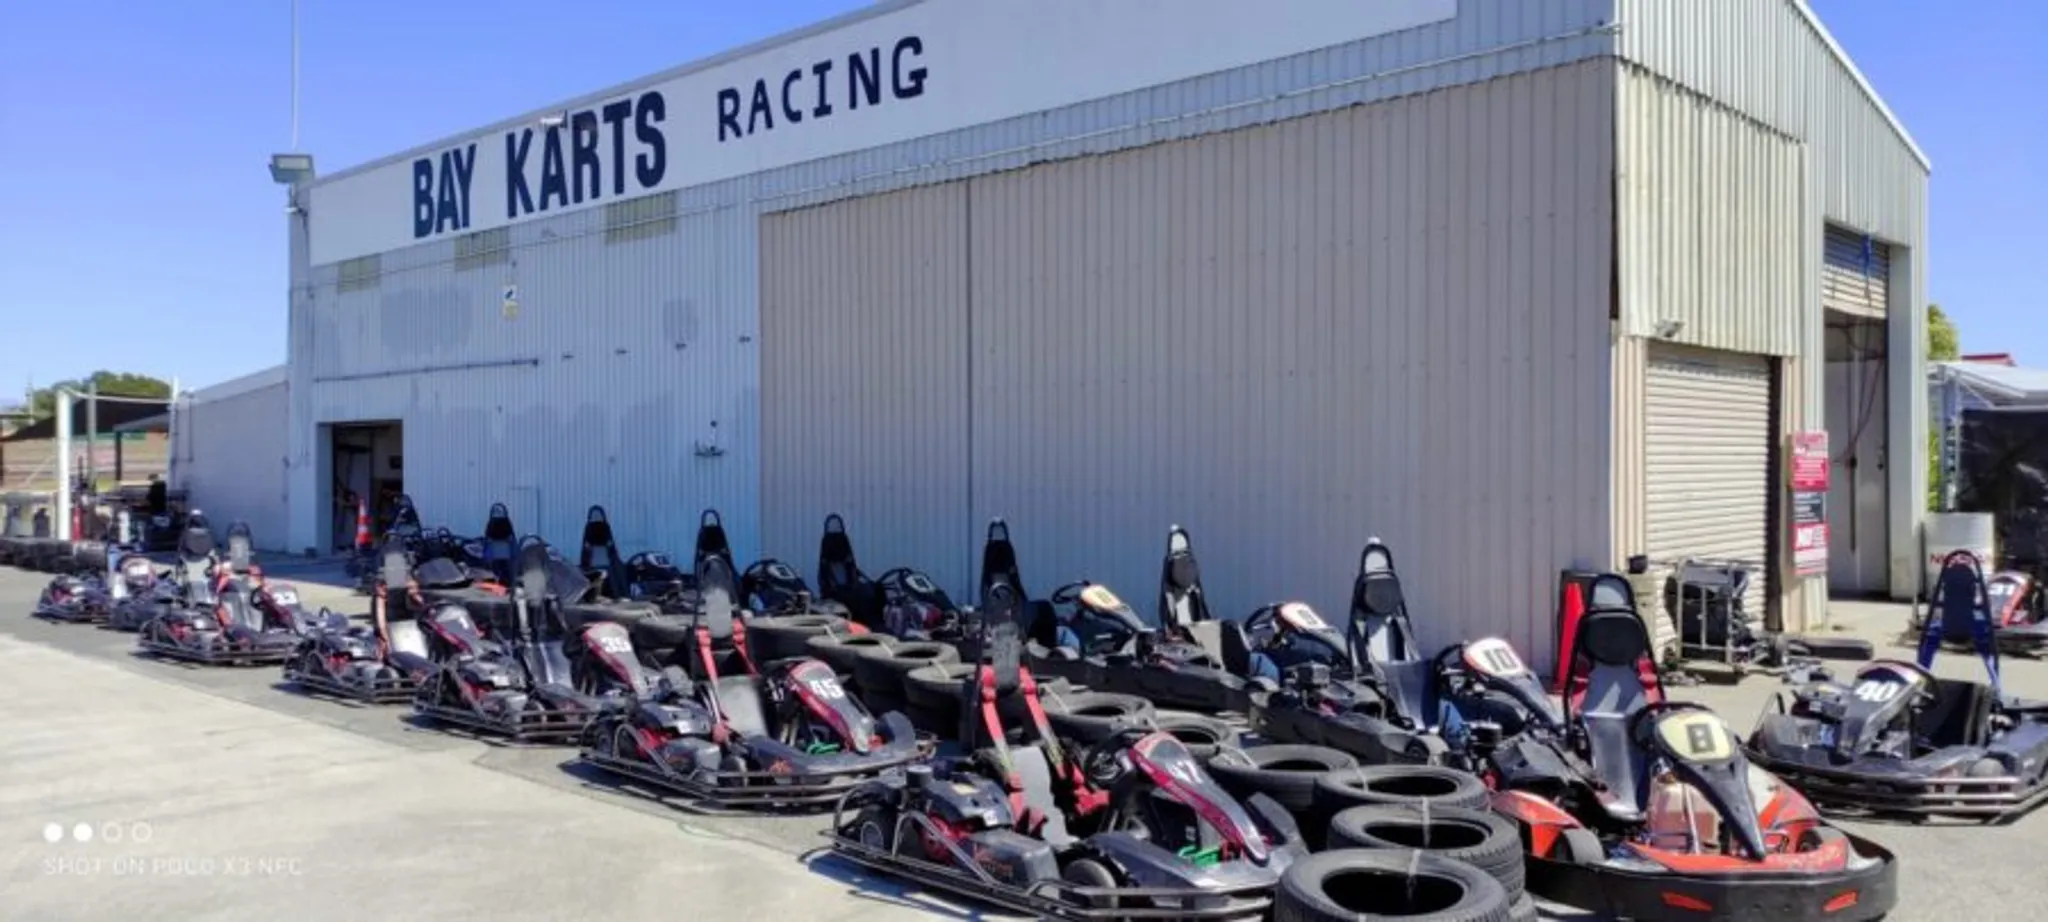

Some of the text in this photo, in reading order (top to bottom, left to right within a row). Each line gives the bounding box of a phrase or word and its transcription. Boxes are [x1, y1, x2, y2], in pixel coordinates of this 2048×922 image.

[413, 36, 928, 239] BAY KARTS RACING
[1483, 648, 1518, 672] 10
[808, 679, 845, 700] 45
[1853, 680, 1899, 702] 40
[1685, 723, 1716, 755] 8
